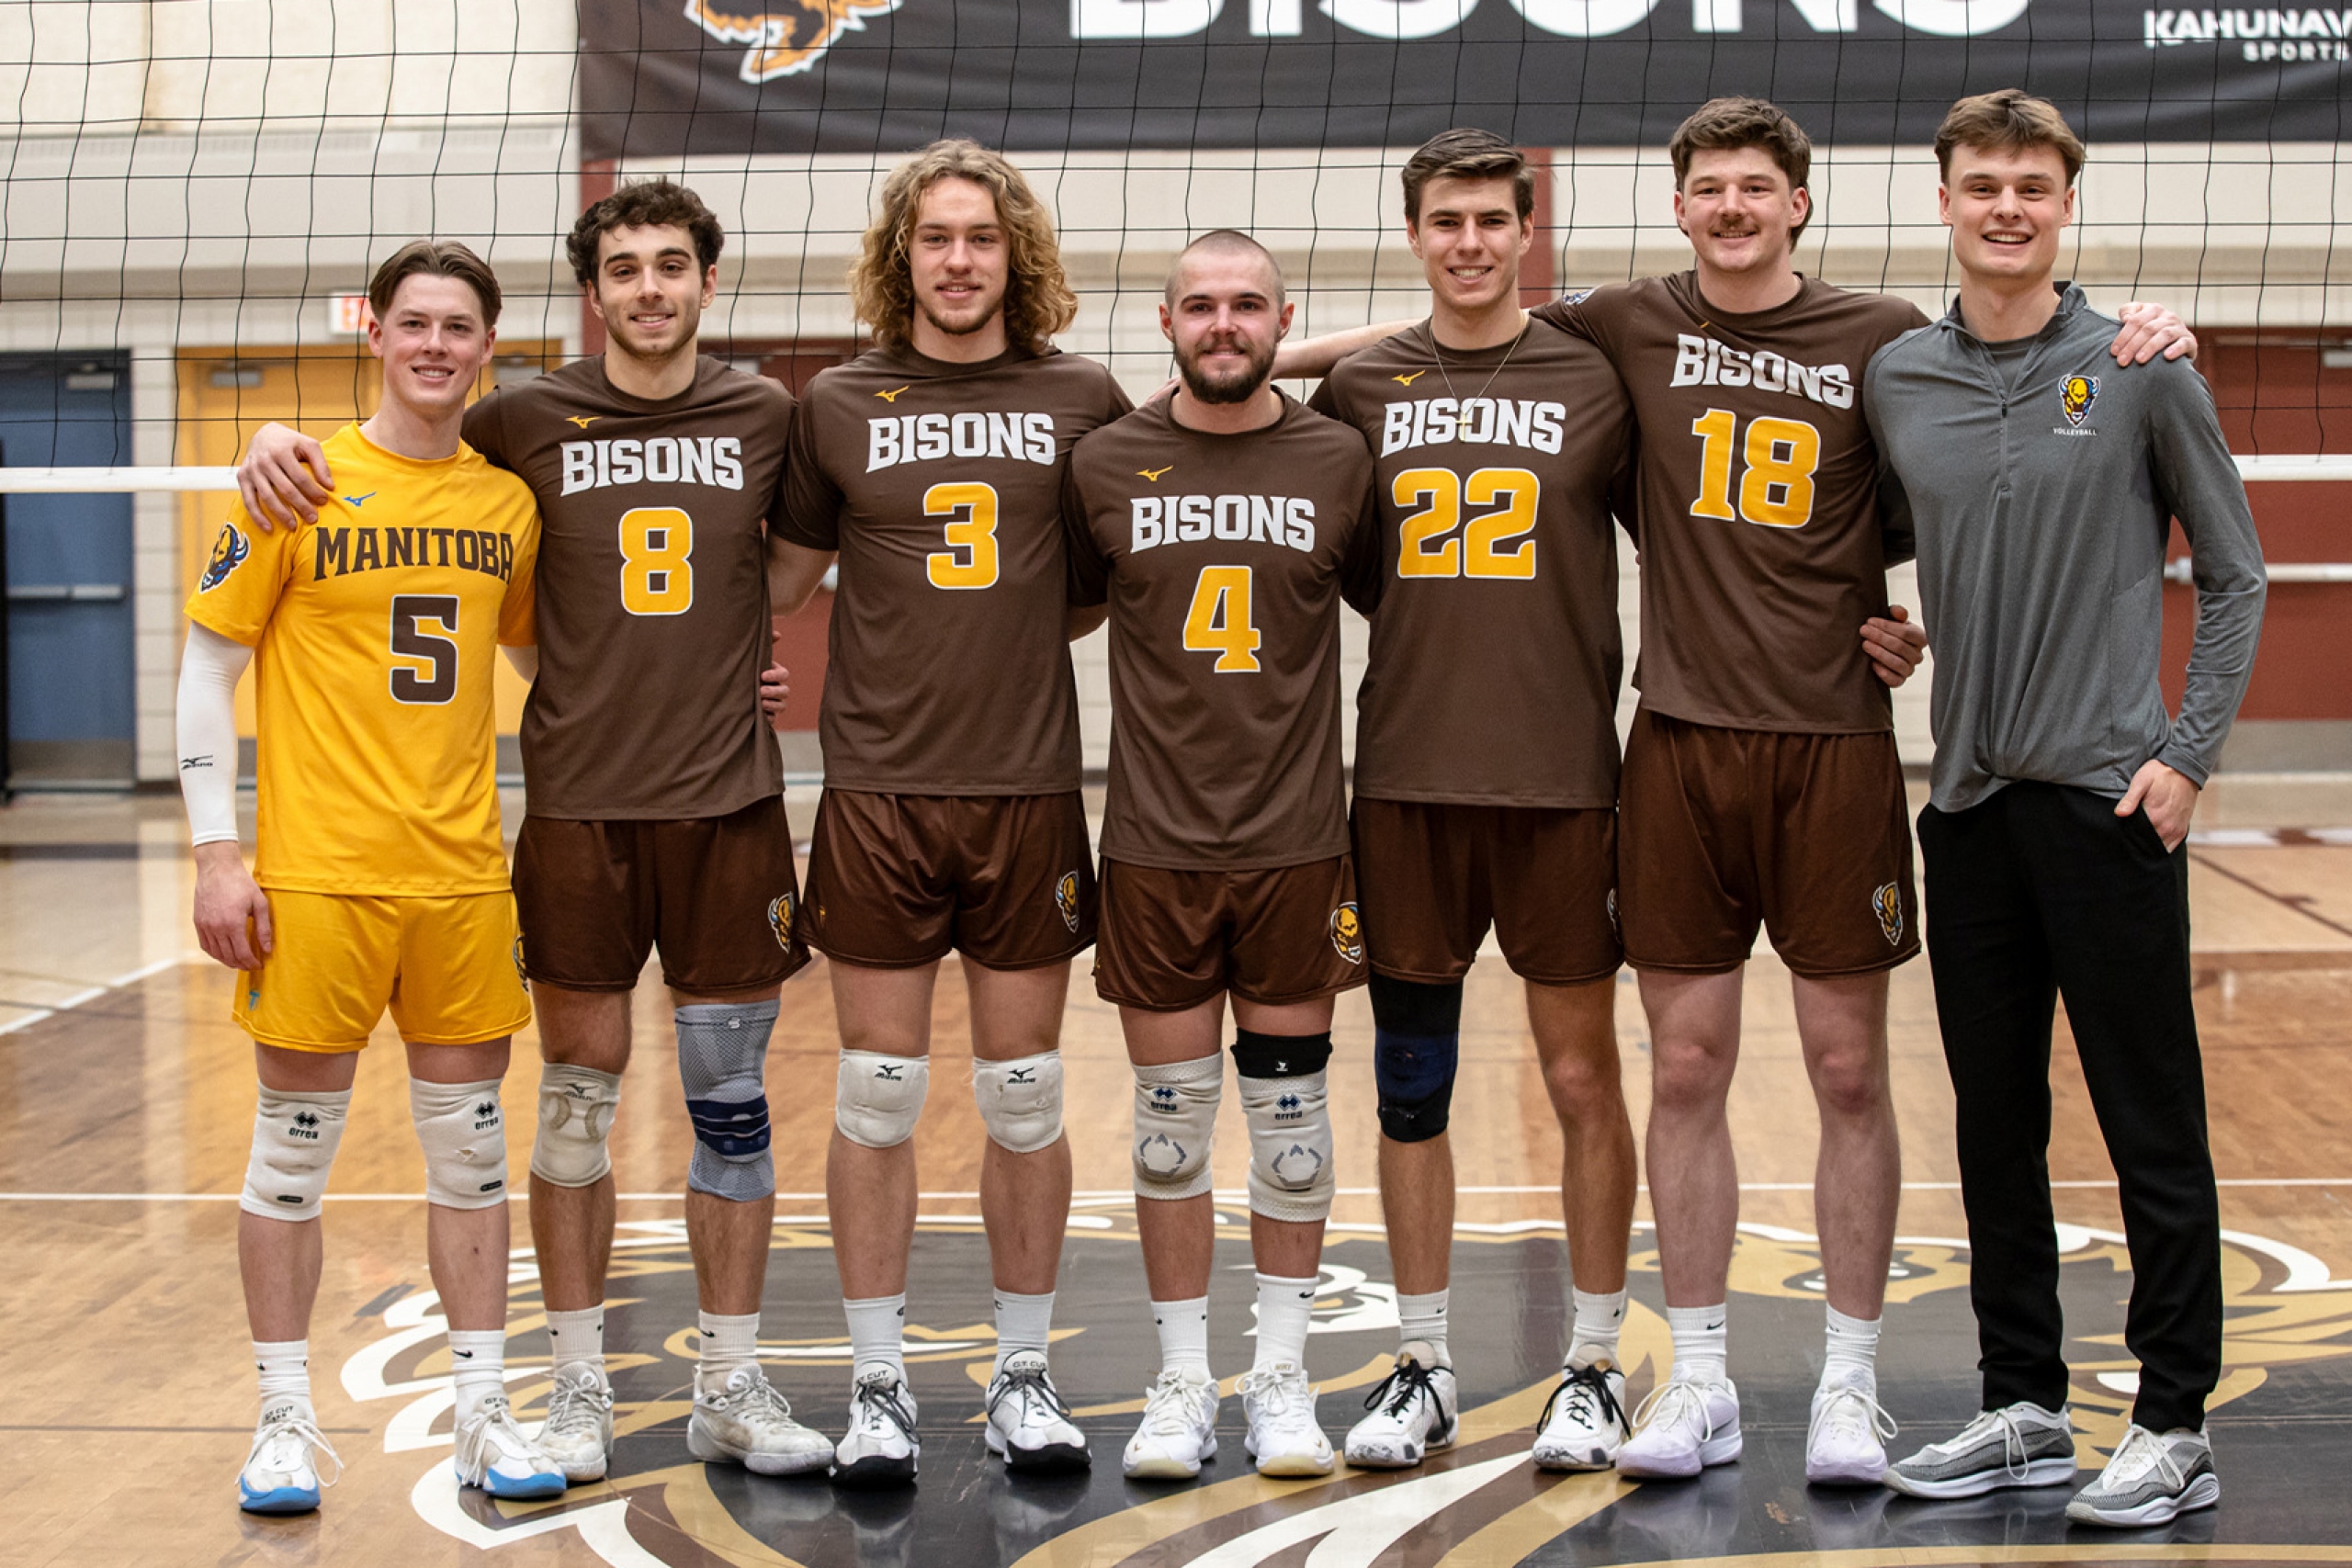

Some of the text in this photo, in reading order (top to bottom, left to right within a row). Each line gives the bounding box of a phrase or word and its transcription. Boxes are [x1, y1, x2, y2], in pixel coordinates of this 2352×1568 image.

[1669, 333, 1855, 410] BISONS
[560, 436, 743, 496] BISONS
[866, 412, 1056, 473] BISONS
[1381, 398, 1566, 458] BISONS
[2053, 427, 2098, 436] VOLLEYBALL
[1690, 407, 1821, 528] 18
[313, 526, 514, 585] MANITOBA
[618, 506, 694, 615] 8
[922, 480, 1000, 591] 3
[1130, 495, 1316, 554] BISONS
[1391, 467, 1541, 581] 22
[389, 594, 460, 705] 5
[1182, 565, 1261, 673] 4
